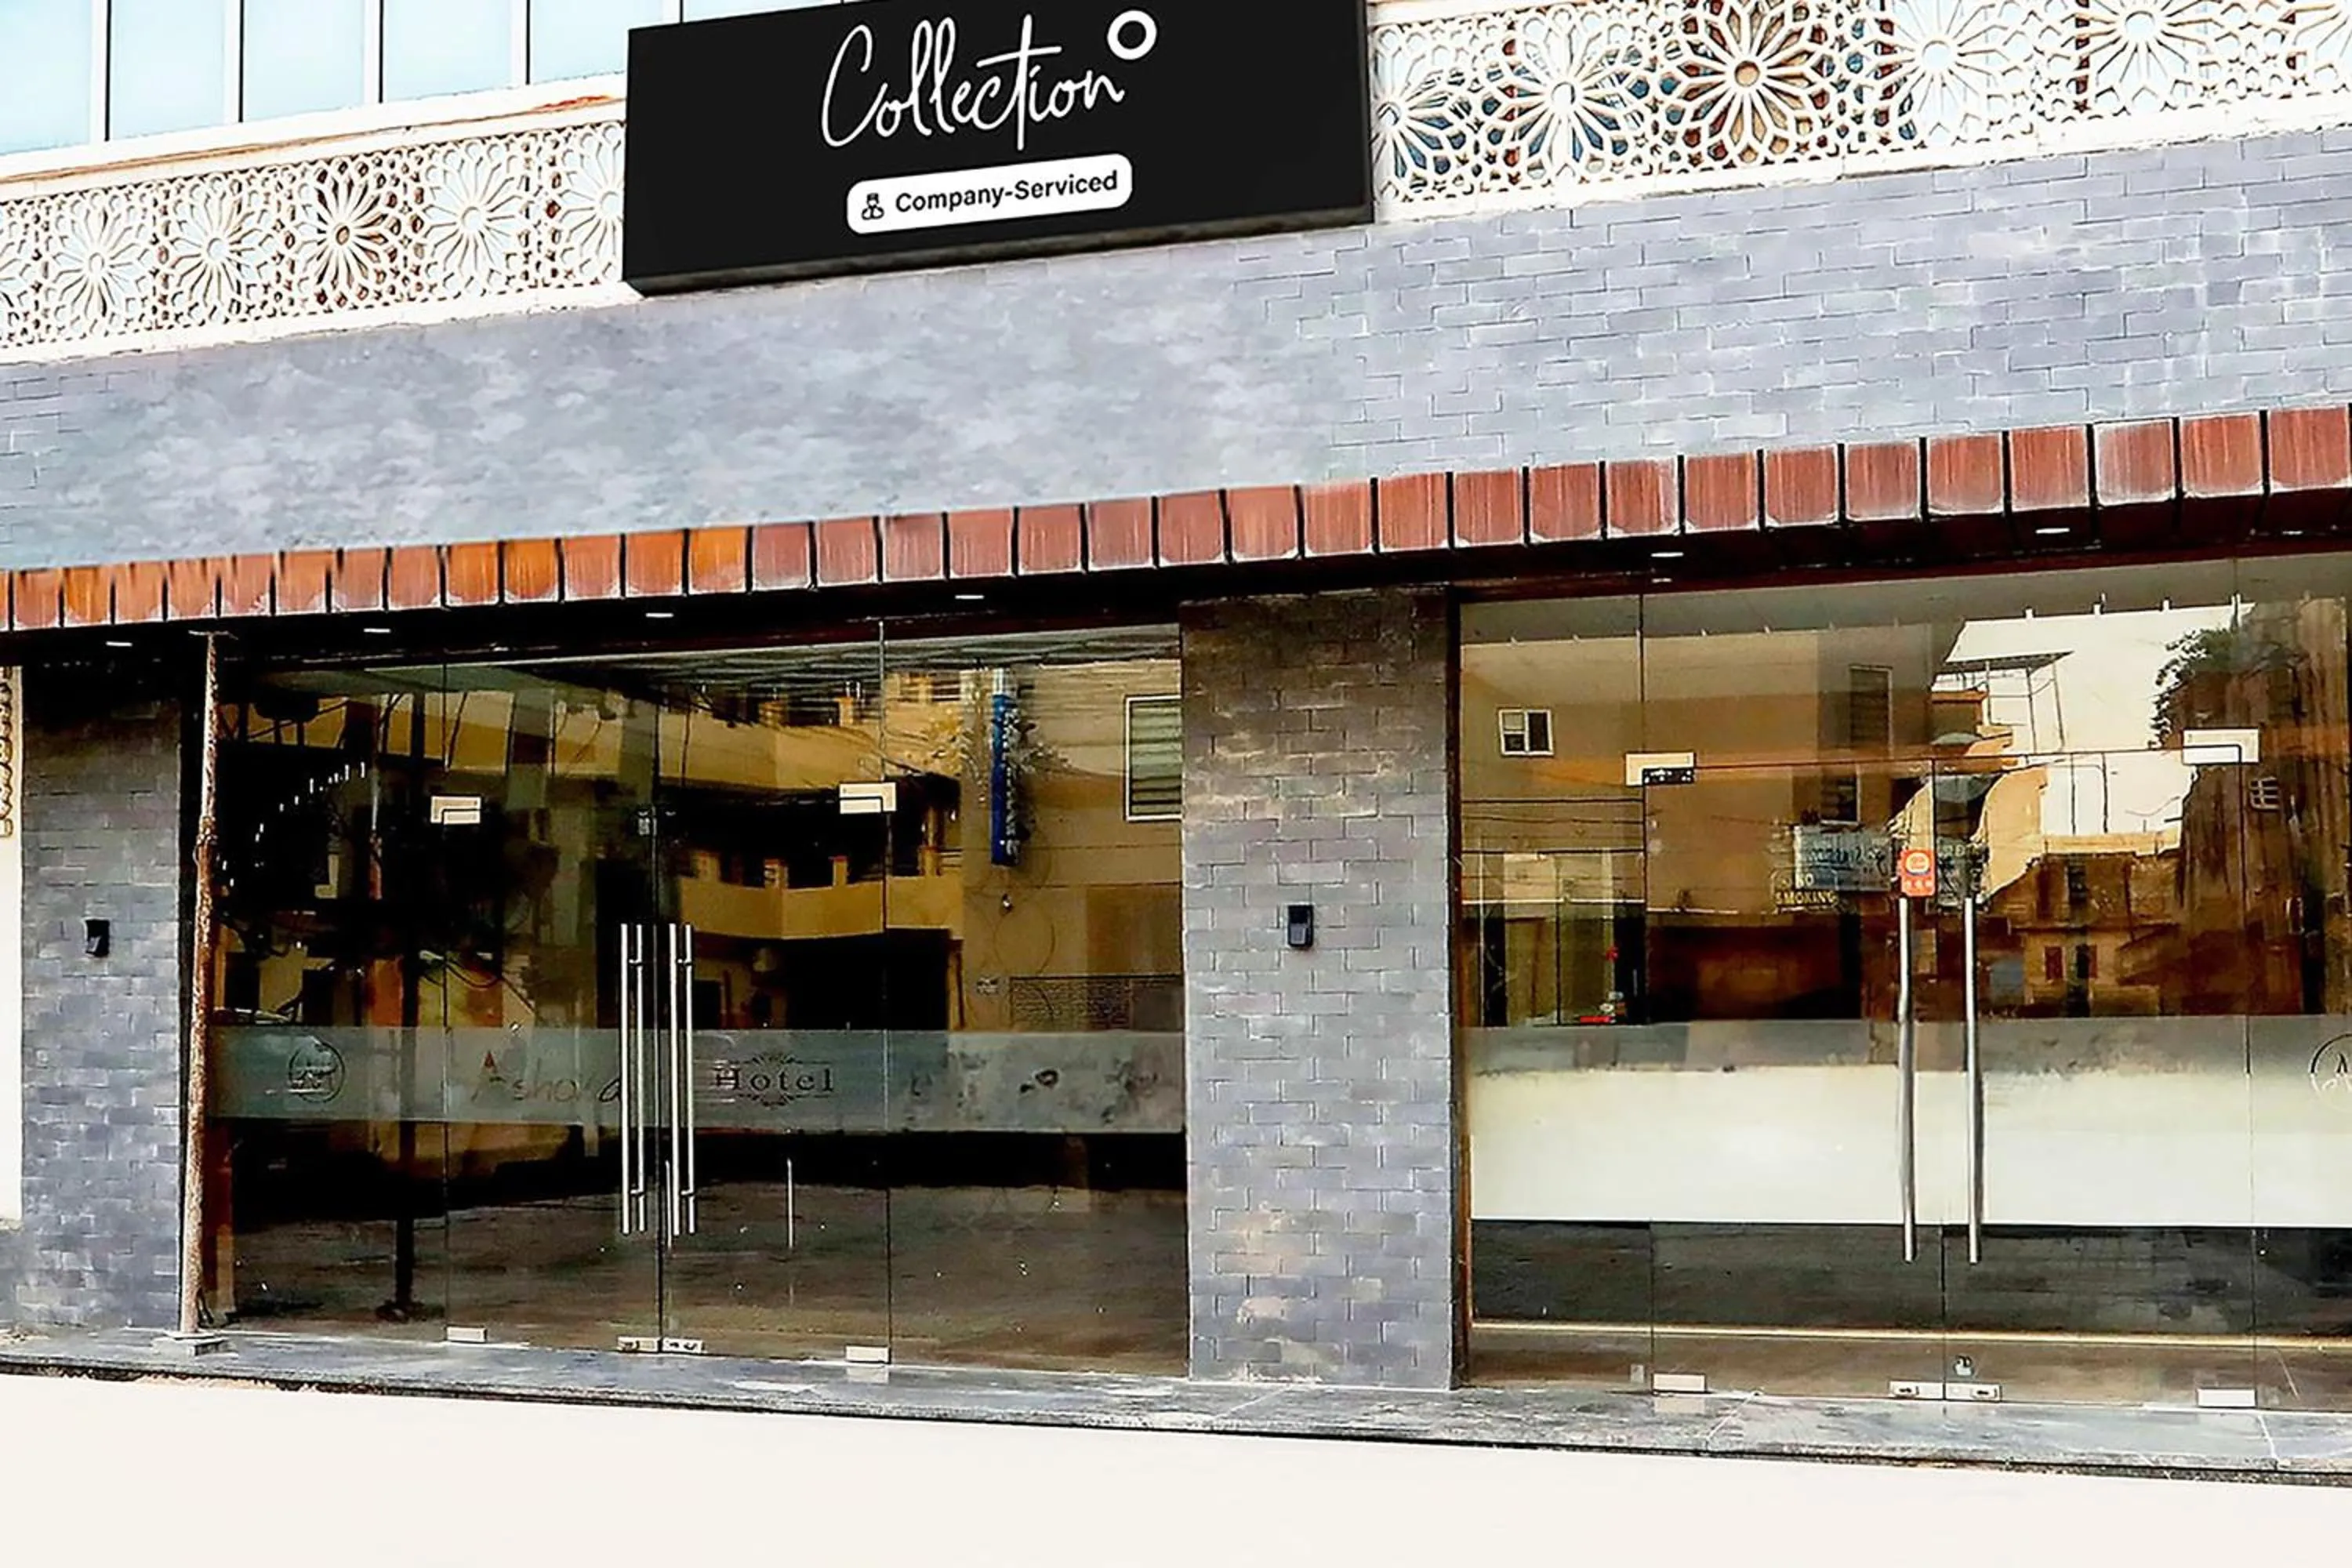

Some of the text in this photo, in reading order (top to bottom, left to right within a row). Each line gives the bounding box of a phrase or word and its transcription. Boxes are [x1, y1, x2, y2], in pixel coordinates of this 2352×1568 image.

[821, 13, 1125, 151] Collection
[895, 169, 1118, 212] Company-Serviced
[470, 1050, 836, 1102] Ashoa Hotel
